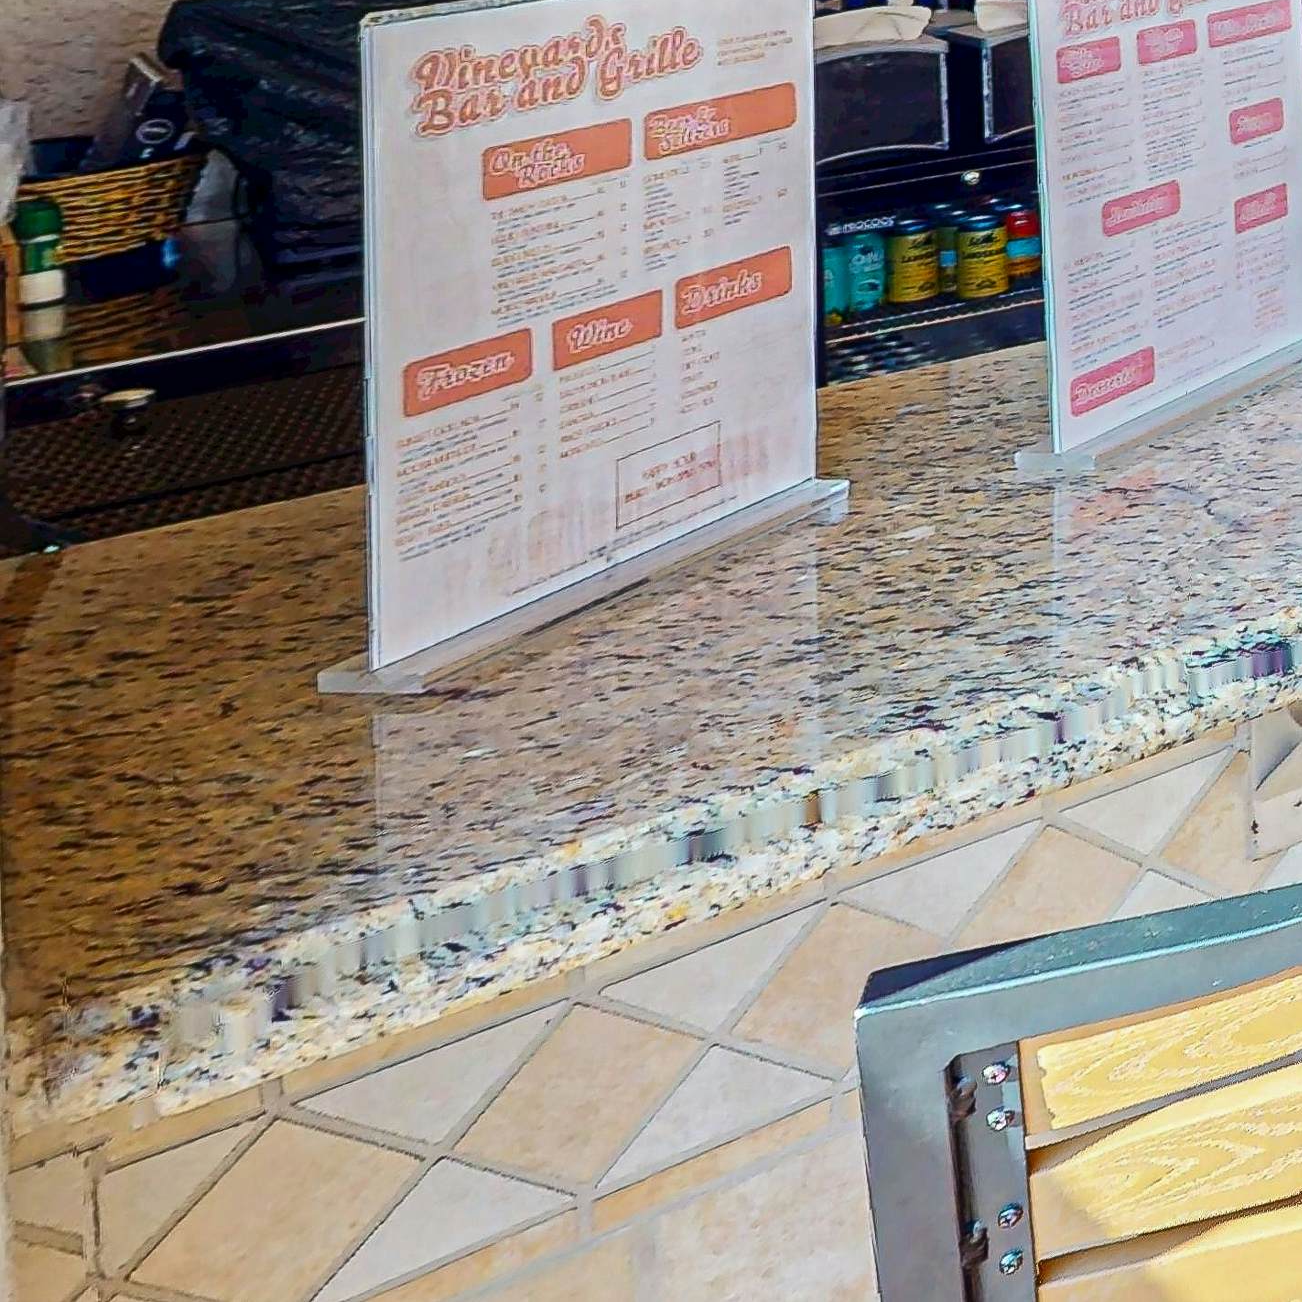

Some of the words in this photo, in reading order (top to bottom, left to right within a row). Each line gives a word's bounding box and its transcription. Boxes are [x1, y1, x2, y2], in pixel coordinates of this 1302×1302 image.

[411, 14, 628, 95] Vineyards
[412, 86, 510, 140] Bar
[510, 52, 591, 112] and
[594, 24, 705, 101] Grille
